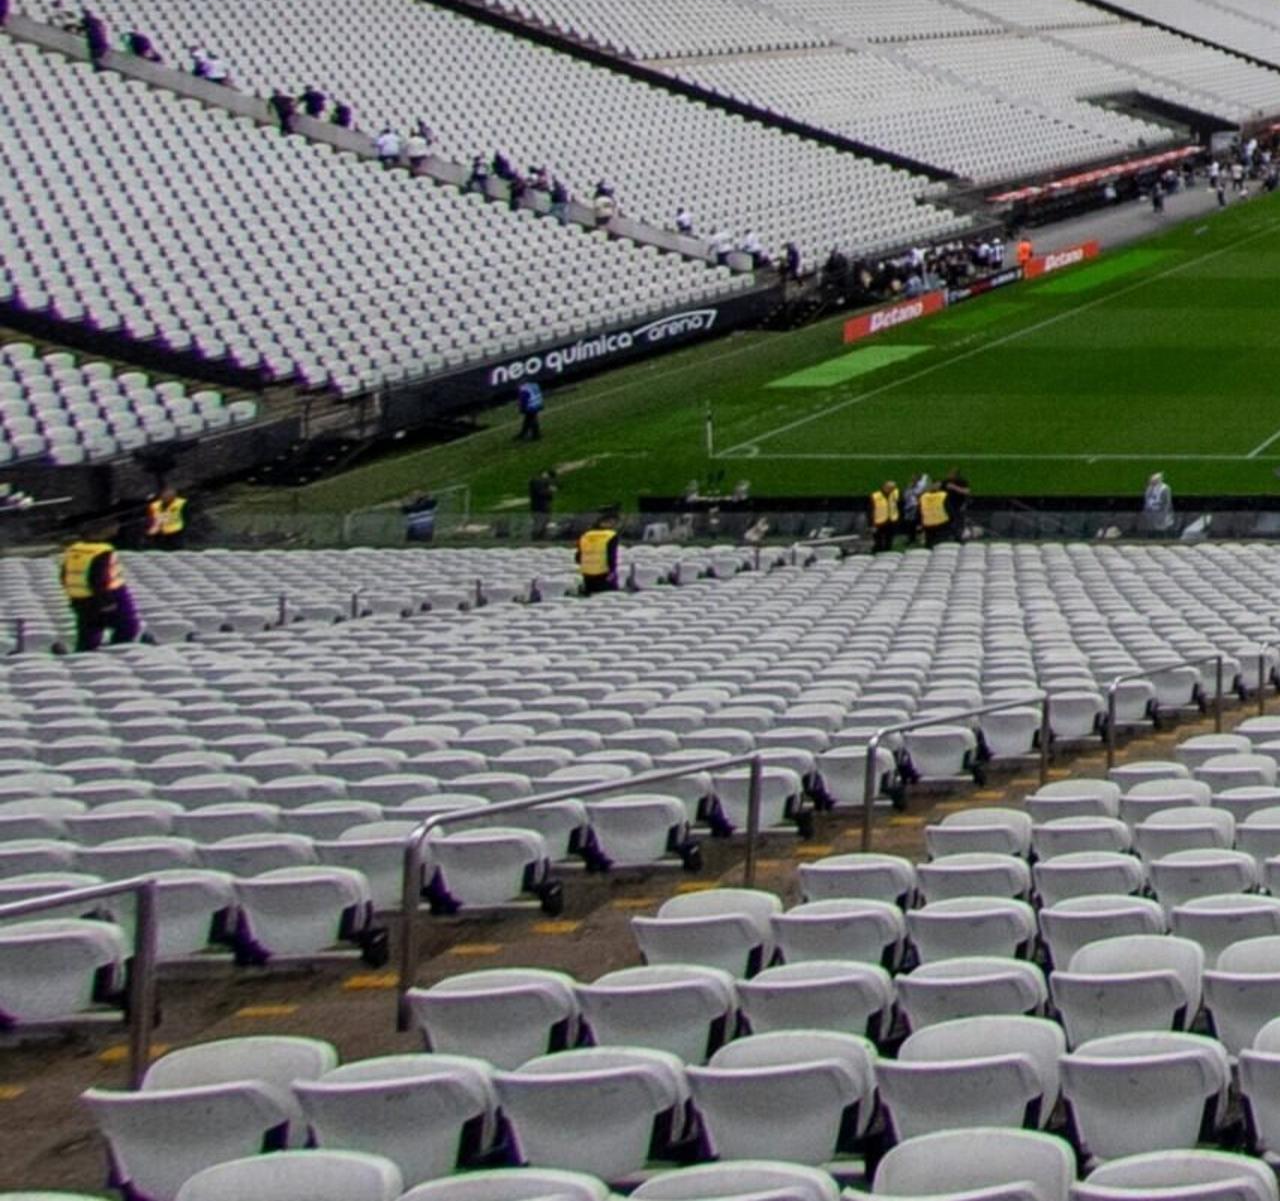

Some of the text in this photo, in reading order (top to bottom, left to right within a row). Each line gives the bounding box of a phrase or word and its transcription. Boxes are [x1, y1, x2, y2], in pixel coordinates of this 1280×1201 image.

[869, 301, 924, 333] Betano
[491, 314, 704, 385] neo química arena
